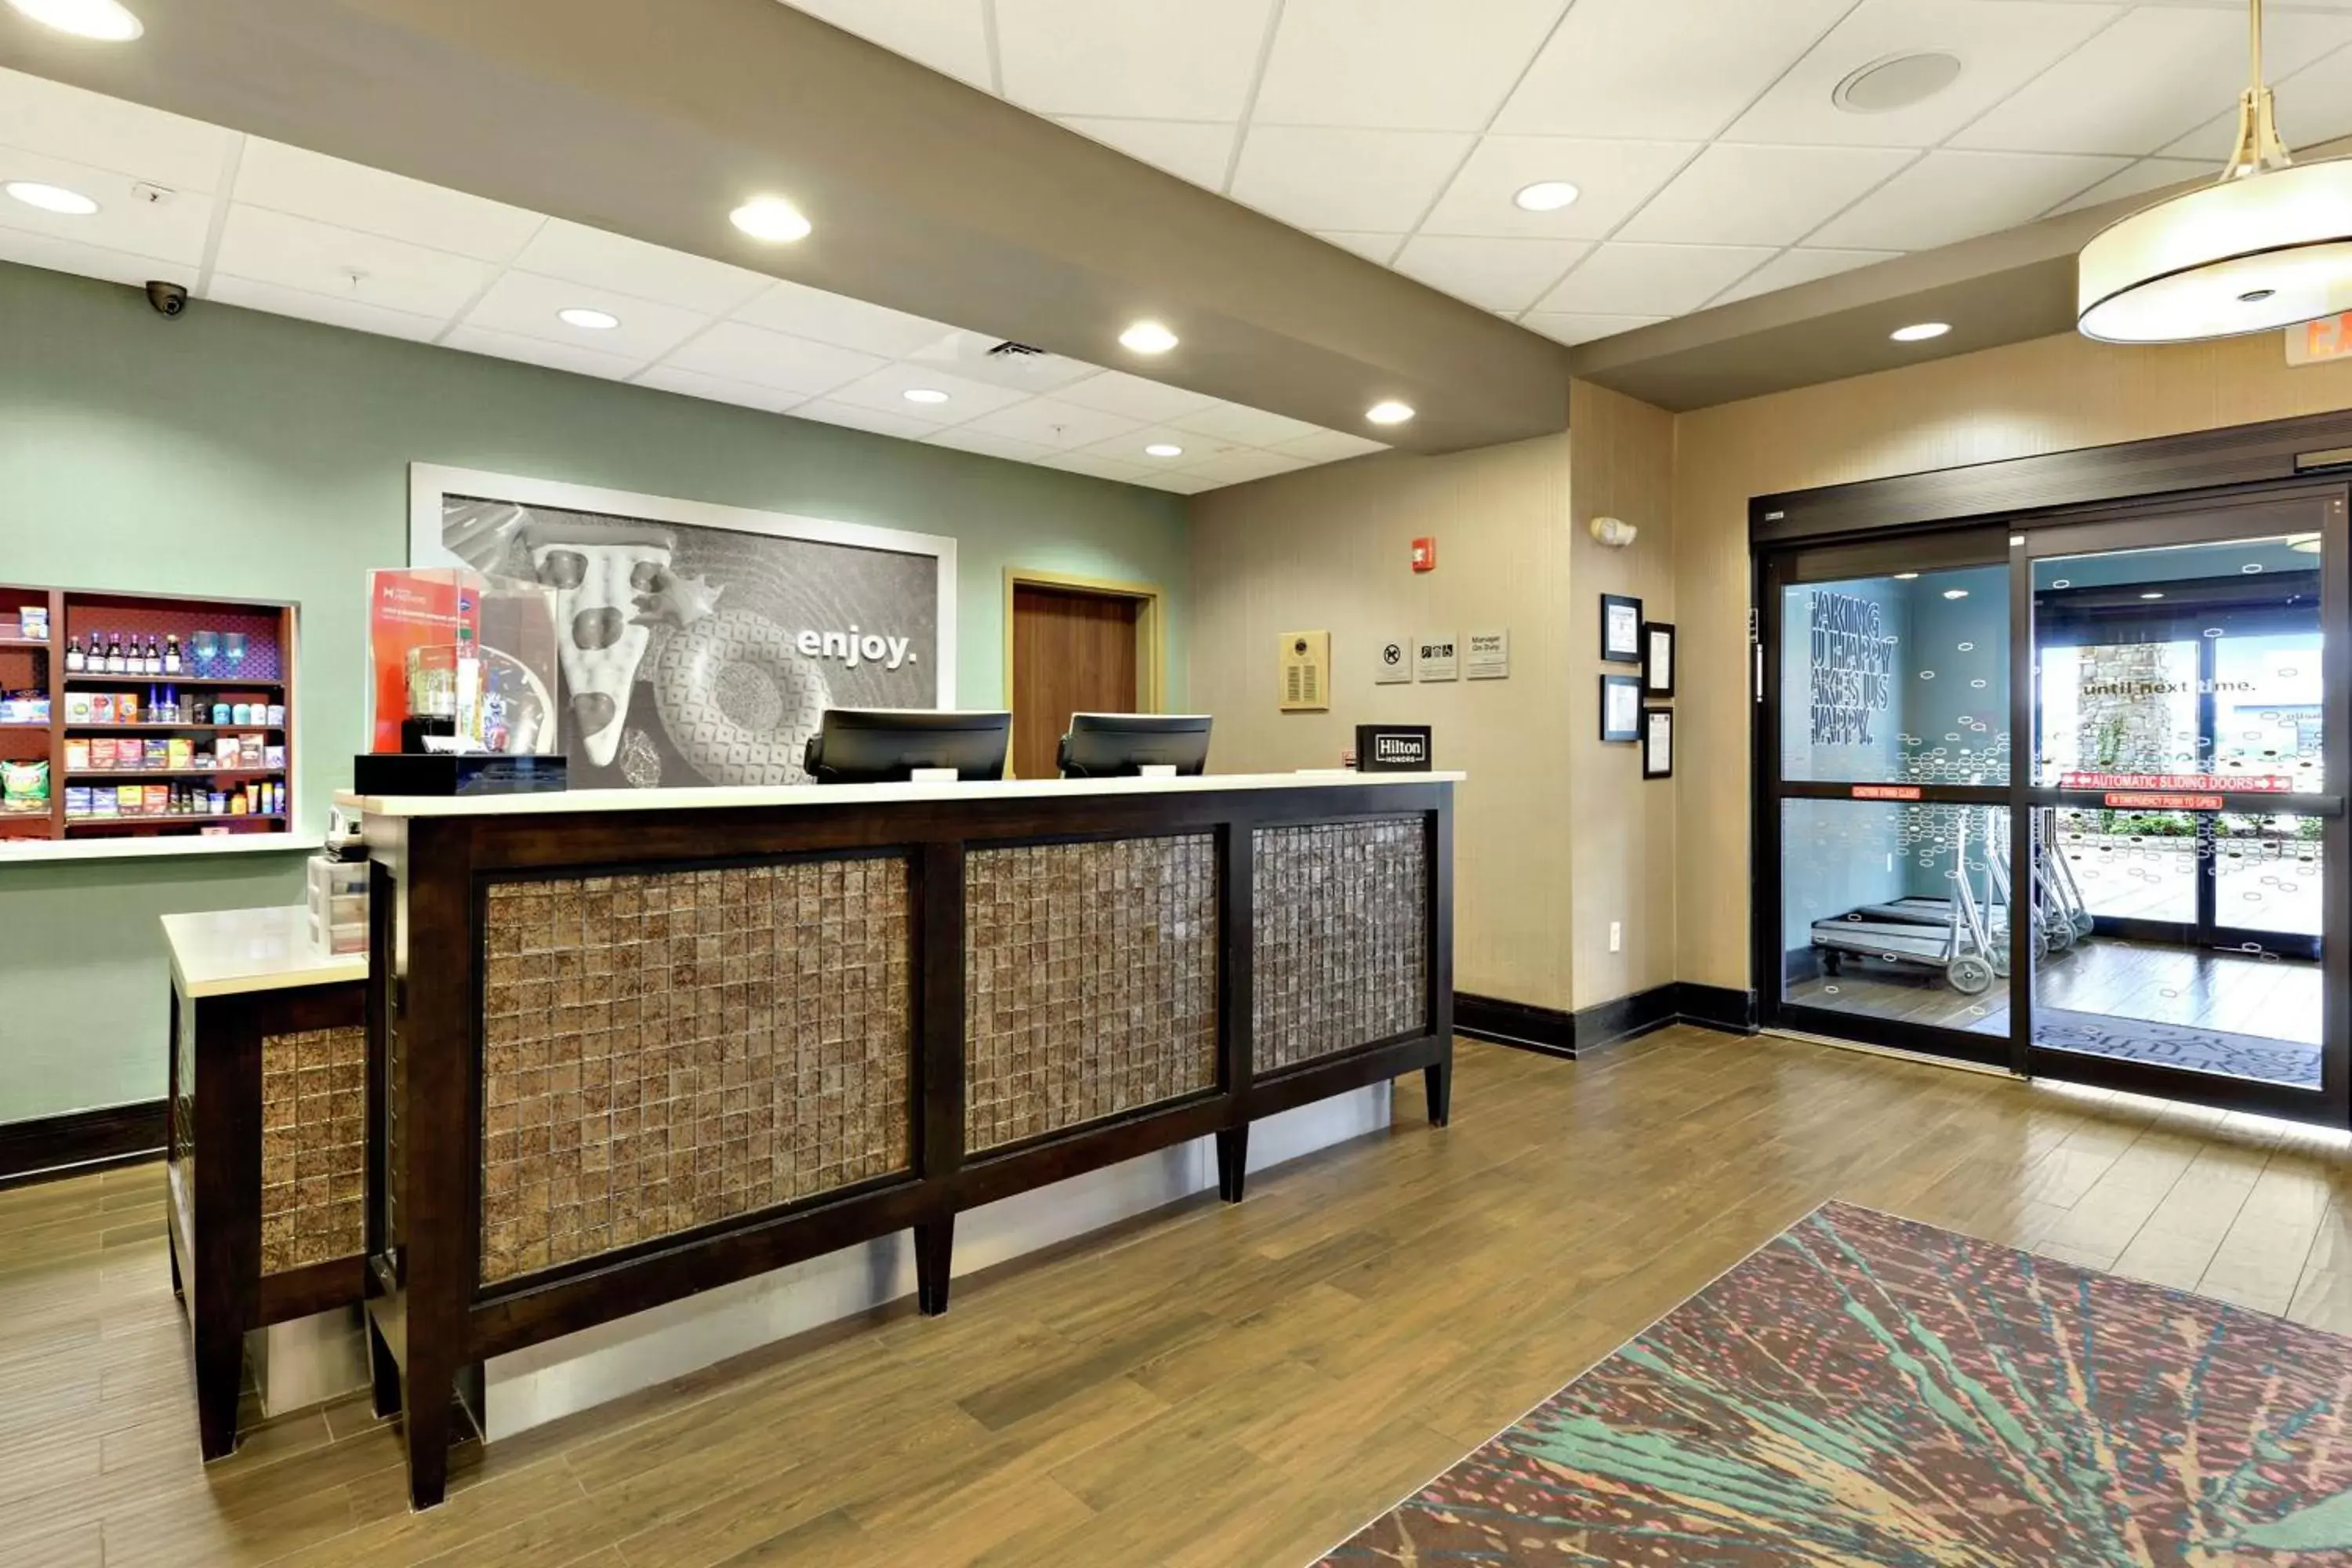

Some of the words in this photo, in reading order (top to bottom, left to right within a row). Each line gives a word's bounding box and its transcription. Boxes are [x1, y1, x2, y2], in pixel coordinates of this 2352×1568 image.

[797, 625, 916, 670] enjoy.
[1829, 631, 1893, 675] HAPPY
[1864, 672, 1889, 711] US
[2083, 680, 2132, 695] until
[2140, 681, 2188, 695] next
[2198, 678, 2257, 693] time.
[1380, 739, 1421, 754] Hilton
[2092, 775, 2157, 788] AUTOMATIC
[2160, 775, 2207, 789] SLIDING
[2210, 777, 2255, 789] DOORS
